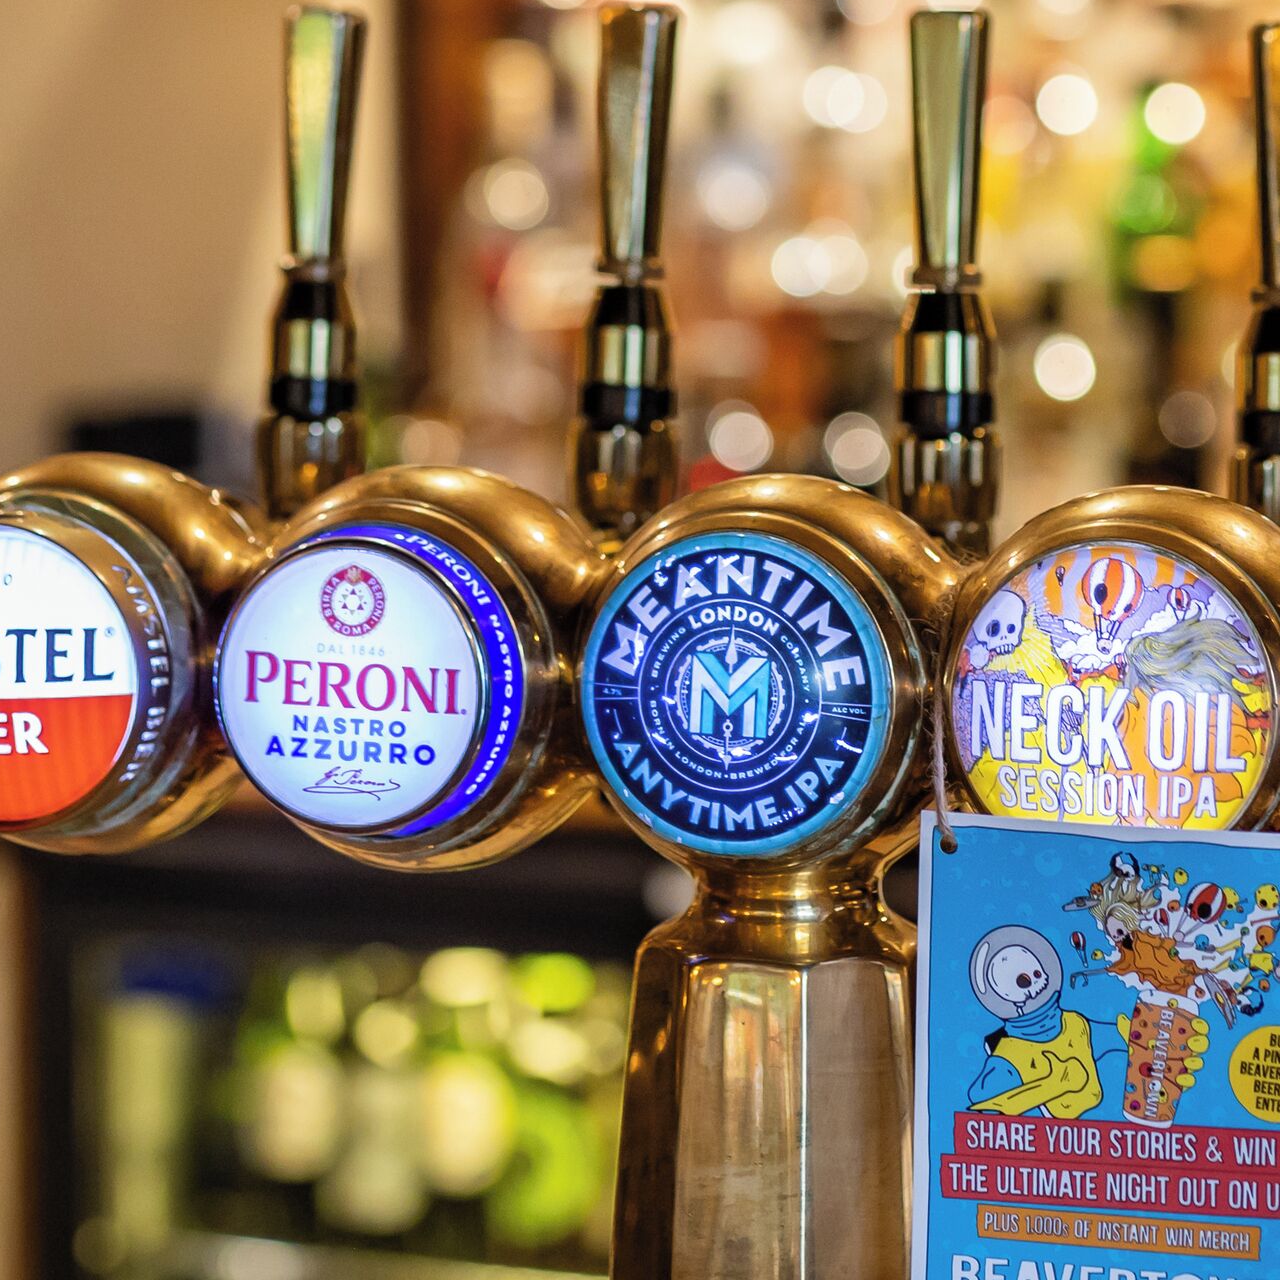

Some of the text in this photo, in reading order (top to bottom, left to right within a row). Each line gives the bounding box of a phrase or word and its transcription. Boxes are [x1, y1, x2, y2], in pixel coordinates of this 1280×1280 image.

[322, 576, 384, 622] BIRRA PERONI
[405, 534, 492, 606] PERONI
[489, 614, 513, 699] NASTRO
[601, 554, 865, 691] MEANTIME
[333, 621, 371, 635] ROMA
[651, 628, 686, 678] BREWING
[689, 605, 780, 636] LONDON
[244, 650, 461, 714] PERONI
[292, 715, 406, 738] NASTRO
[832, 706, 847, 714] ALC
[971, 679, 1247, 773] NECK OIL
[265, 735, 435, 765] AZZURRO
[650, 700, 665, 734] BORN
[675, 751, 722, 779] LONDON
[613, 742, 844, 831] ANYTIME IPA
[730, 753, 779, 779] BREWED
[999, 765, 1218, 818] SESSION IPA
[1253, 1047, 1260, 1061] A
[1254, 1079, 1280, 1096] BEER
[966, 1120, 1276, 1167] SHARE YOUR STORIES & WIN
[949, 1163, 987, 1193] THE
[996, 1166, 1097, 1200] ULTIMATE
[1106, 1173, 1169, 1205] NIGHT
[1178, 1177, 1219, 1208] OUT
[1228, 1181, 1257, 1210] ON
[984, 1212, 1019, 1233] PLUS
[1074, 1219, 1092, 1239] OF
[1098, 1221, 1158, 1245] INSTANT
[1165, 1227, 1192, 1248] WIN
[1199, 1230, 1250, 1252] MERCH
